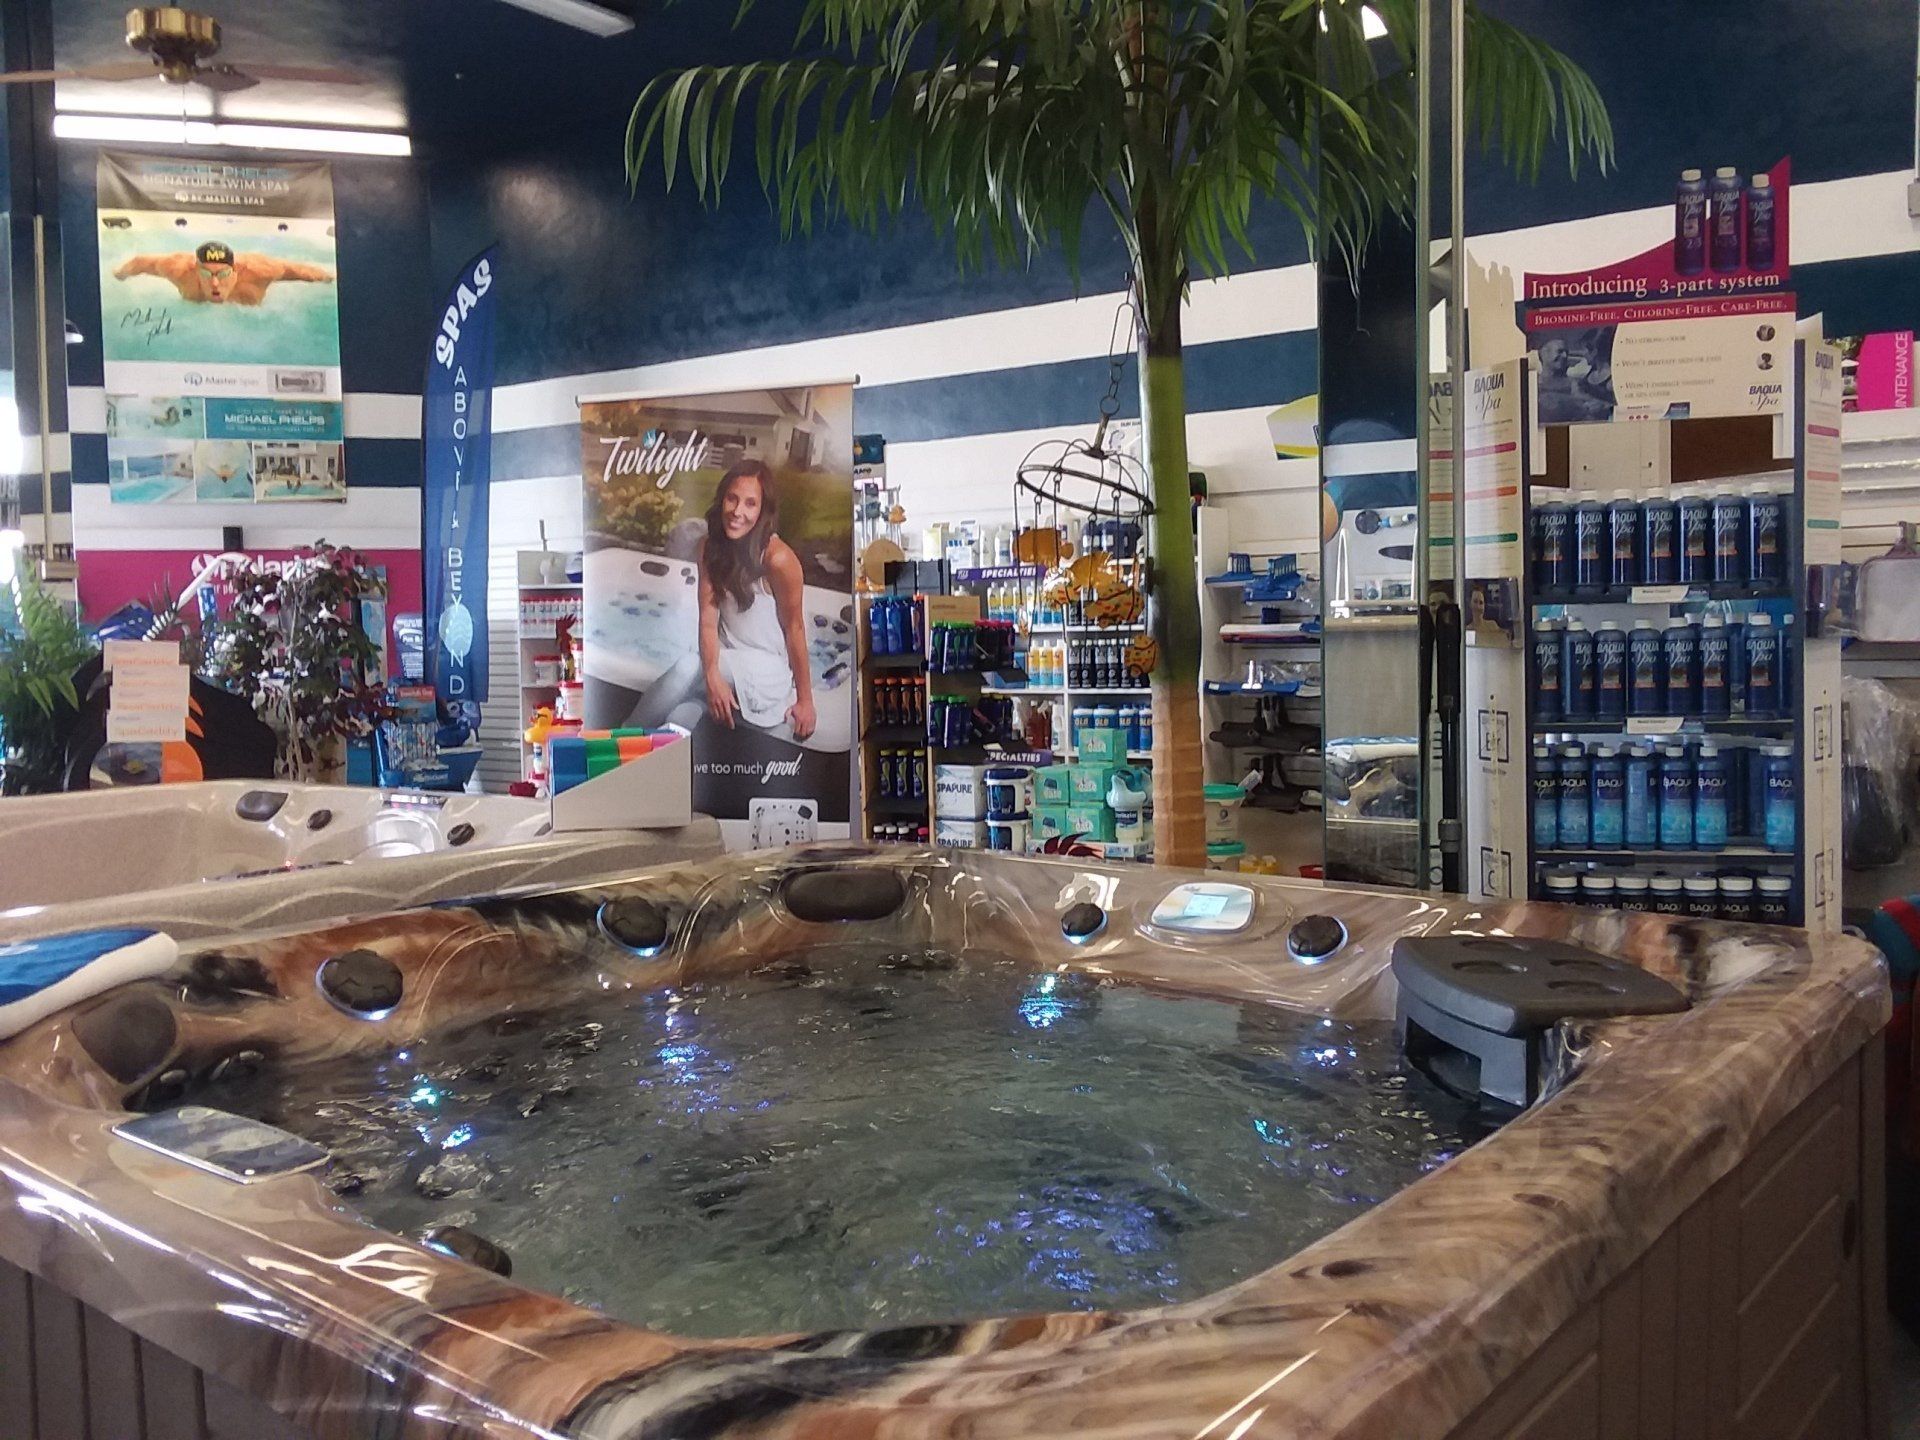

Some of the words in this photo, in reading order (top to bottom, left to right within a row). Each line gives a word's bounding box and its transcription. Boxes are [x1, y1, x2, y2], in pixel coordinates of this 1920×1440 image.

[1531, 273, 1648, 299] Introducing
[1659, 278, 1713, 298] 3-part
[1719, 273, 1780, 294] system
[435, 257, 493, 371] SPAS
[1473, 373, 1505, 394] BAQUA
[1749, 384, 1783, 396] BAQUA
[1475, 393, 1502, 421] Spa
[1750, 394, 1779, 411] Spa
[224, 413, 277, 425] MICHAEL
[278, 414, 326, 426] PHELPS
[599, 428, 709, 490] Twilight
[693, 763, 708, 774] ve
[711, 763, 731, 774] too
[733, 761, 763, 775] much
[936, 783, 973, 794] SPAPURE
